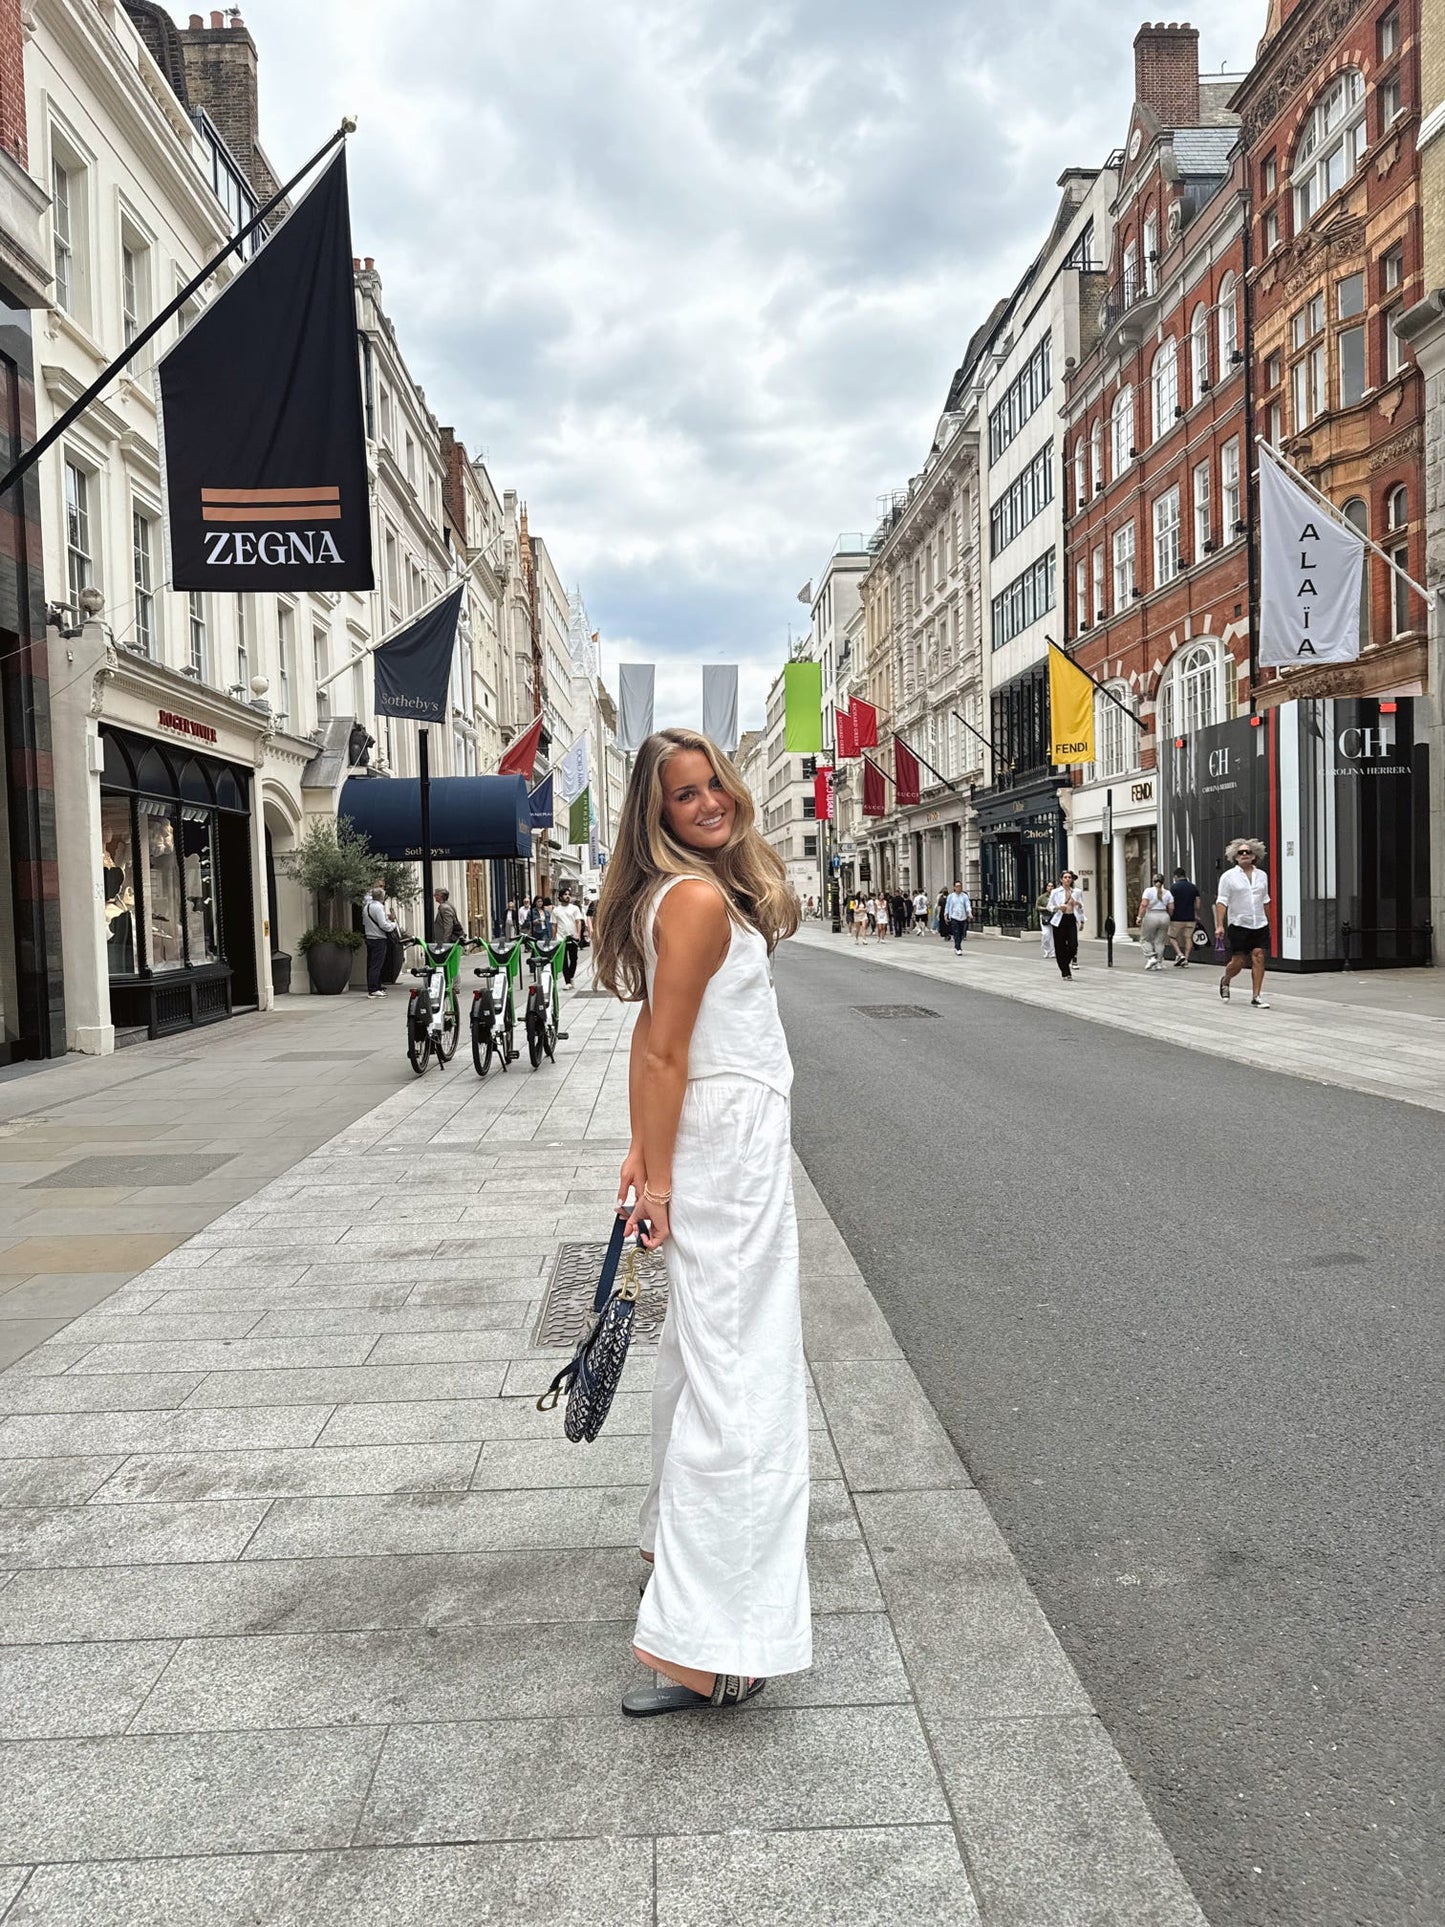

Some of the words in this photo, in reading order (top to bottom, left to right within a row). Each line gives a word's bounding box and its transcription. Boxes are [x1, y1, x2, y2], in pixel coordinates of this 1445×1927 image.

[203, 530, 346, 566] ZEGNA
[1297, 523, 1321, 656] ALAÏA
[381, 692, 440, 713] Sotheby's
[1055, 741, 1088, 755] FENDI
[1338, 727, 1391, 760] CH
[1208, 746, 1230, 778] CH
[1317, 767, 1365, 777] CROLINA
[1366, 765, 1412, 775] HERRERA
[1131, 781, 1153, 802] FENDI
[404, 846, 445, 857] Sothy's
